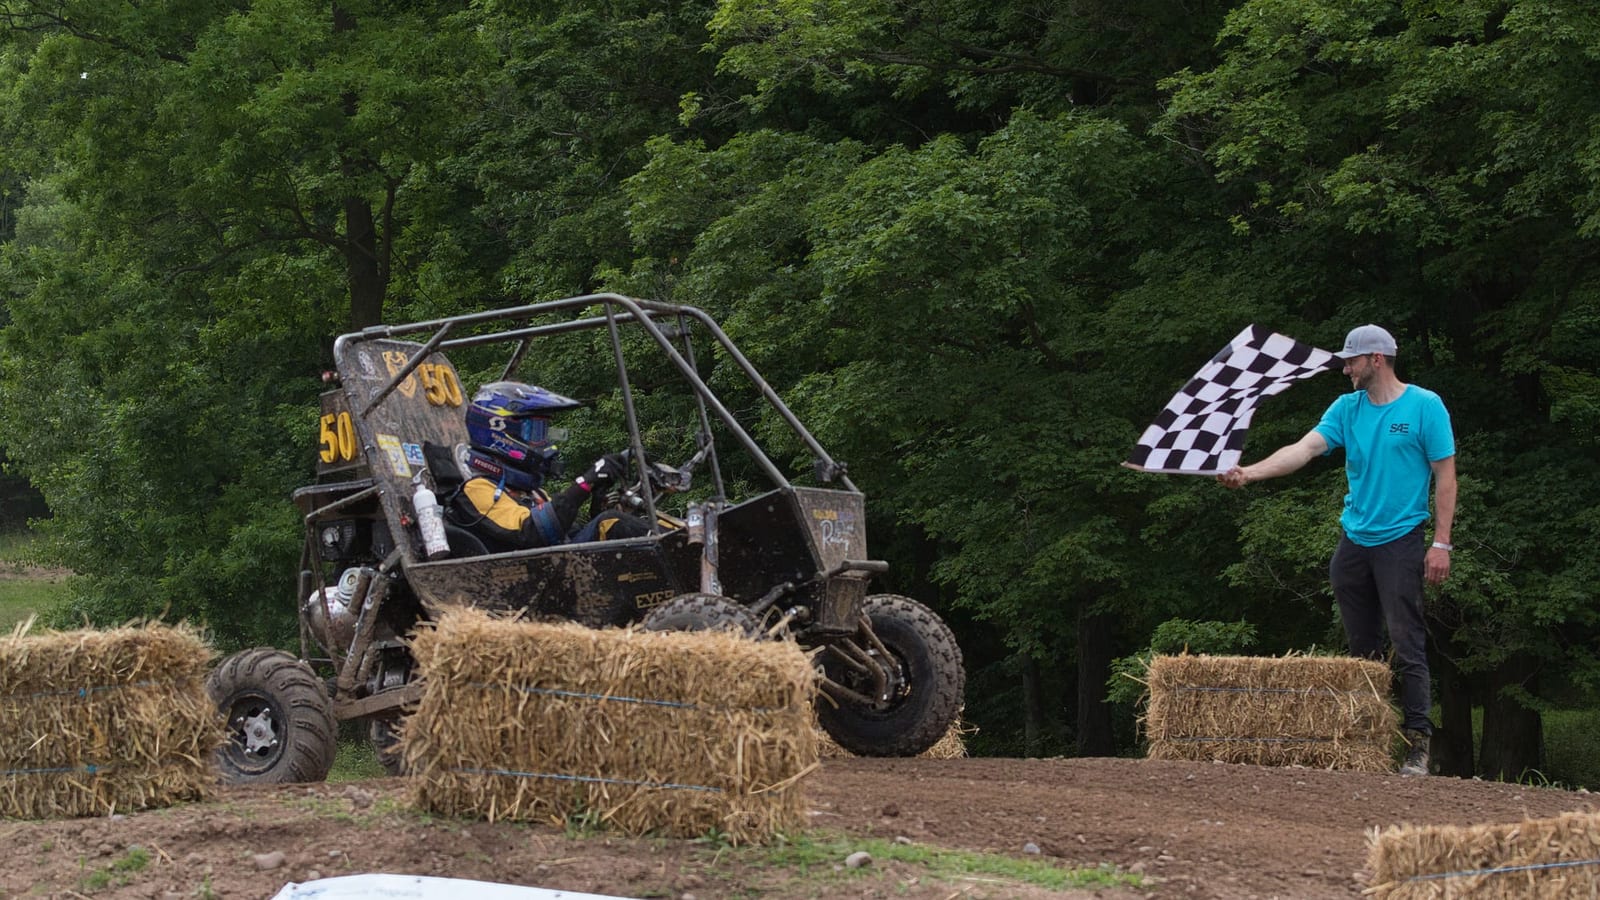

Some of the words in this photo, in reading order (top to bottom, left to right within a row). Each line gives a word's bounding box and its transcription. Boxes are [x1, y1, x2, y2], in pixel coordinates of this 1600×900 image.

[419, 363, 463, 406] 50
[320, 412, 356, 463] 50
[1389, 423, 1410, 434] SAE
